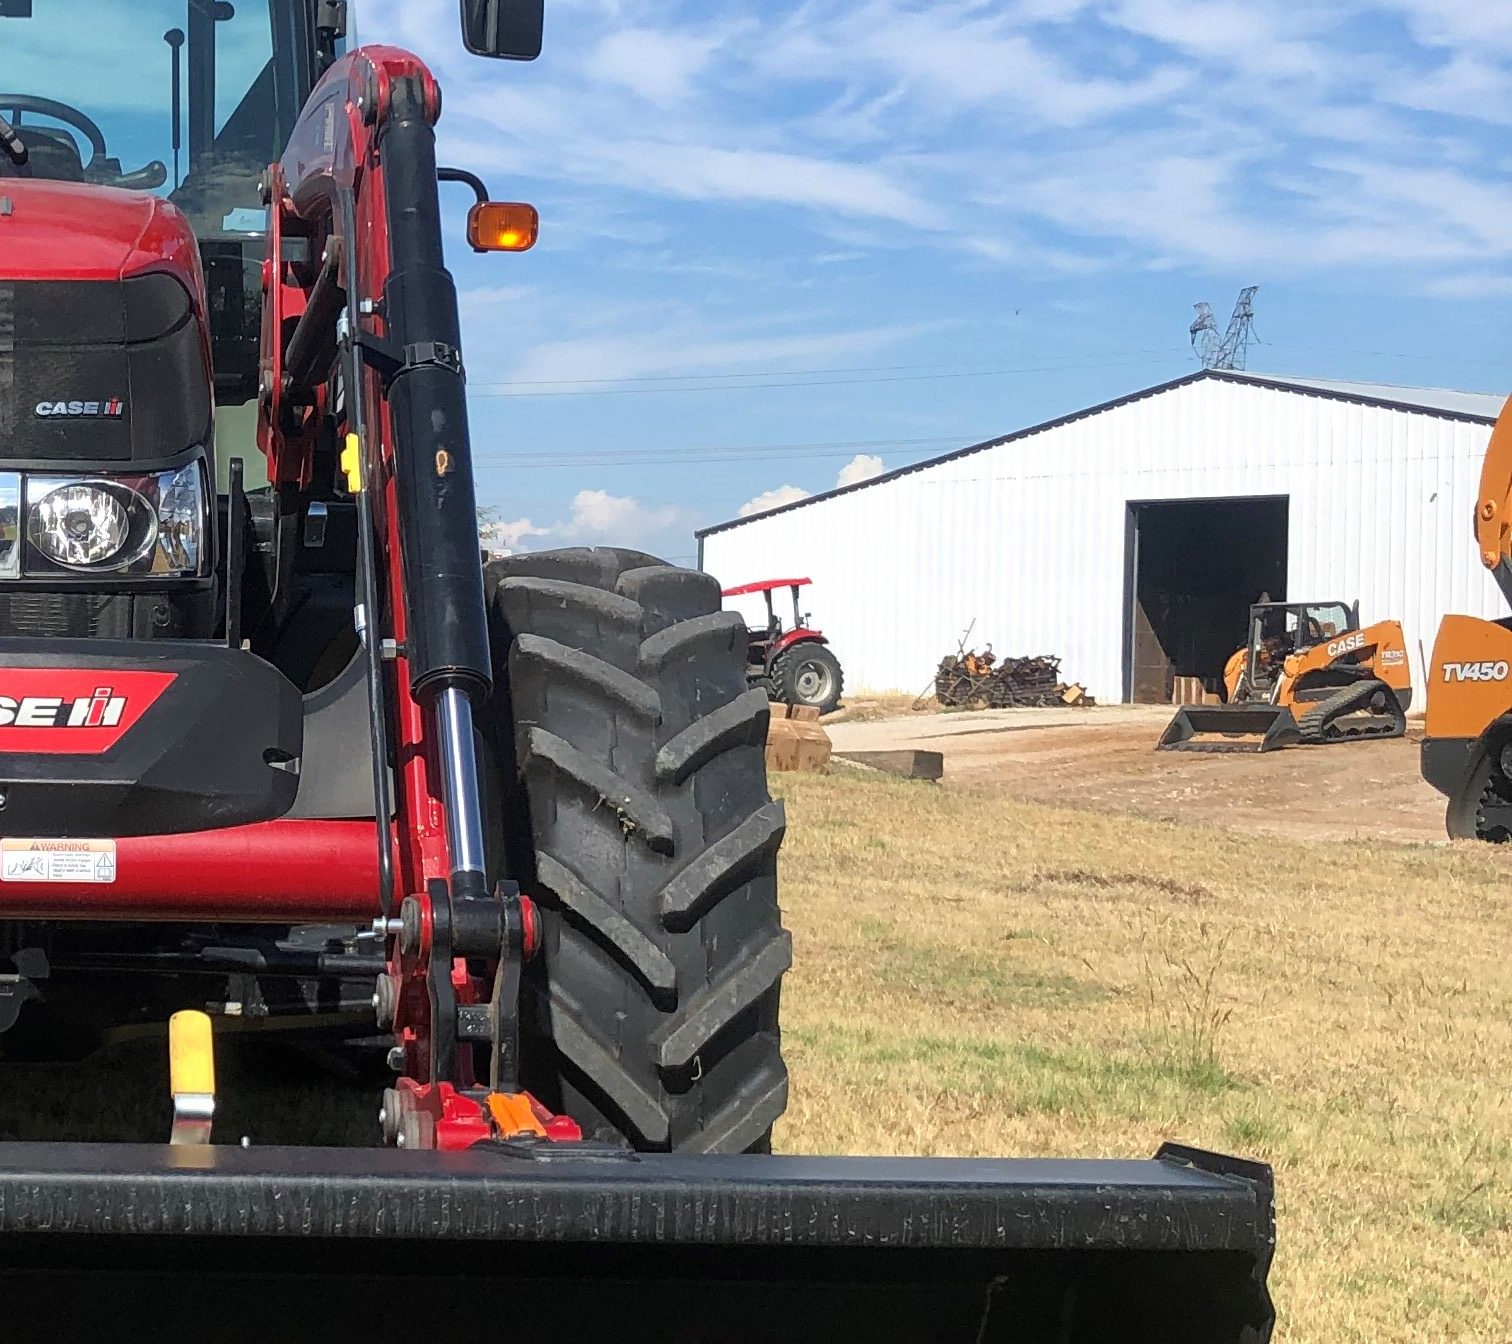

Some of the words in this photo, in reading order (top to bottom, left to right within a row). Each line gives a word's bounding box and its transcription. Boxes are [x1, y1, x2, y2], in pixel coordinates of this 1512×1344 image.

[35, 400, 99, 416] CASE
[1327, 633, 1365, 657] CASE
[1442, 659, 1509, 682] TV450
[40, 842, 90, 852] WARNING
